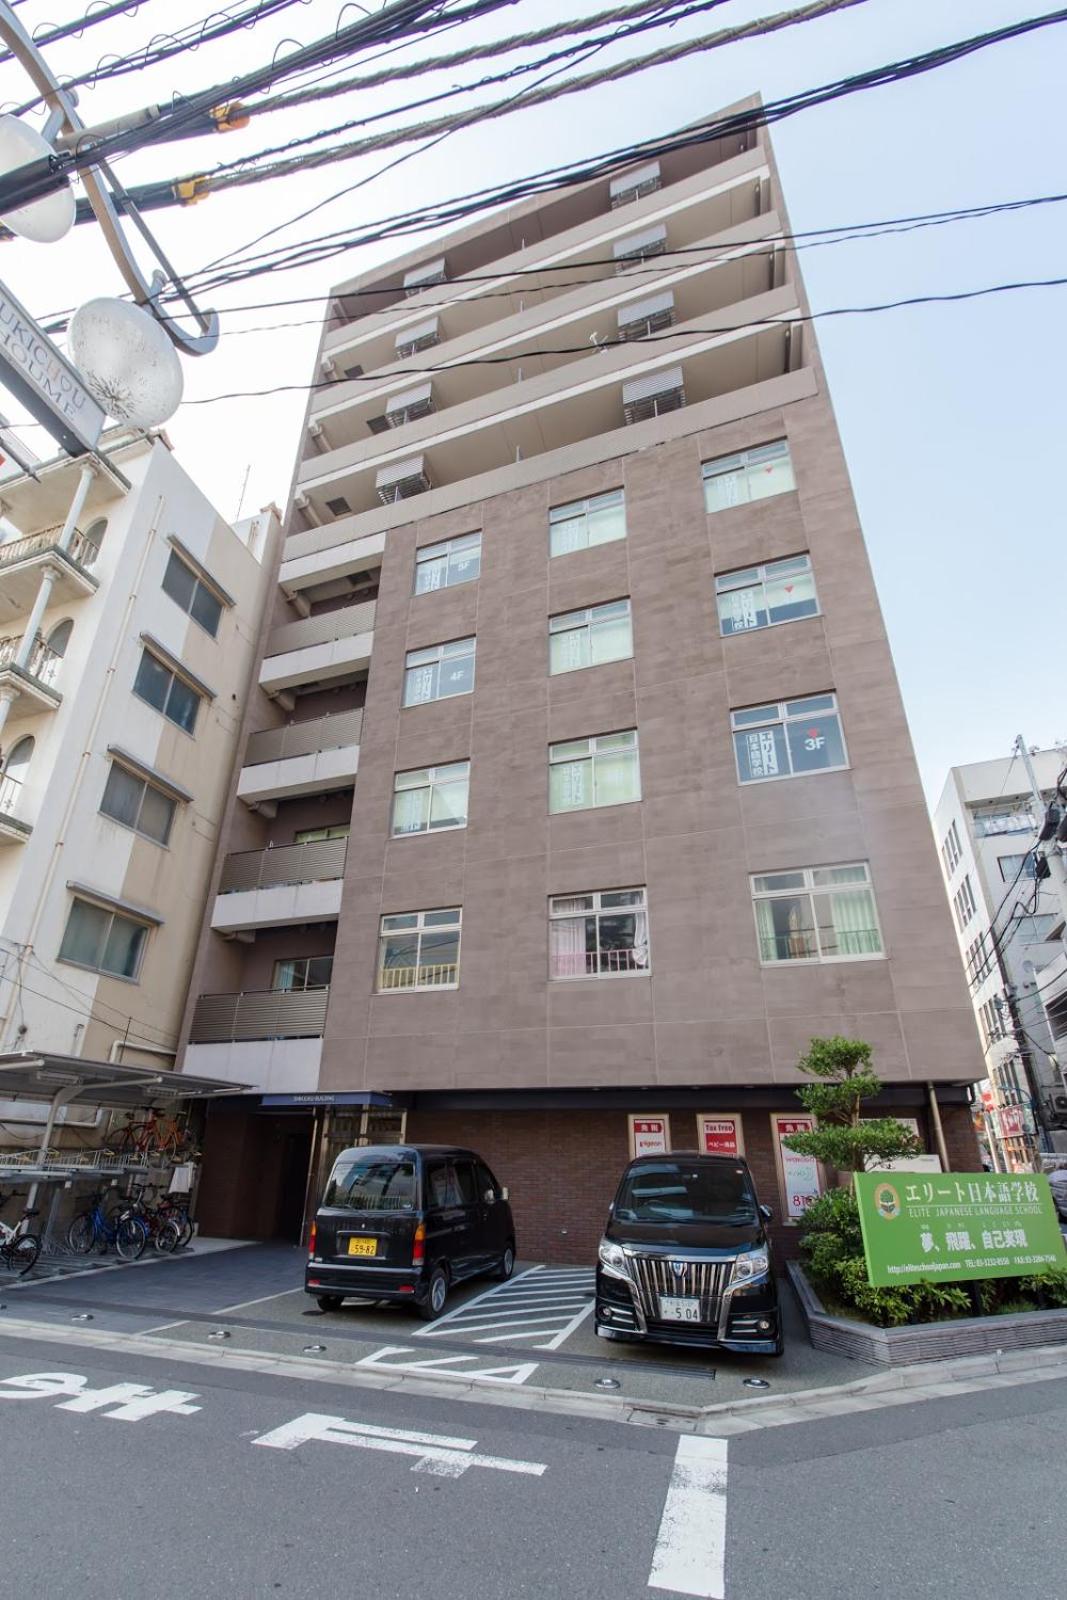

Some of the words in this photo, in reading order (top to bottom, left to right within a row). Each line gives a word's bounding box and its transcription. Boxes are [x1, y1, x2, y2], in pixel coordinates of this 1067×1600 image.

[450, 669, 465, 681] 4F
[804, 736, 825, 751] 3F
[906, 1181, 1040, 1203] エリート日本語学校
[909, 1207, 931, 1218] ELITE
[936, 1206, 974, 1217] JAPANESE
[975, 1204, 1013, 1216] LANGUAGE
[1015, 1203, 1043, 1215] SCHOOL
